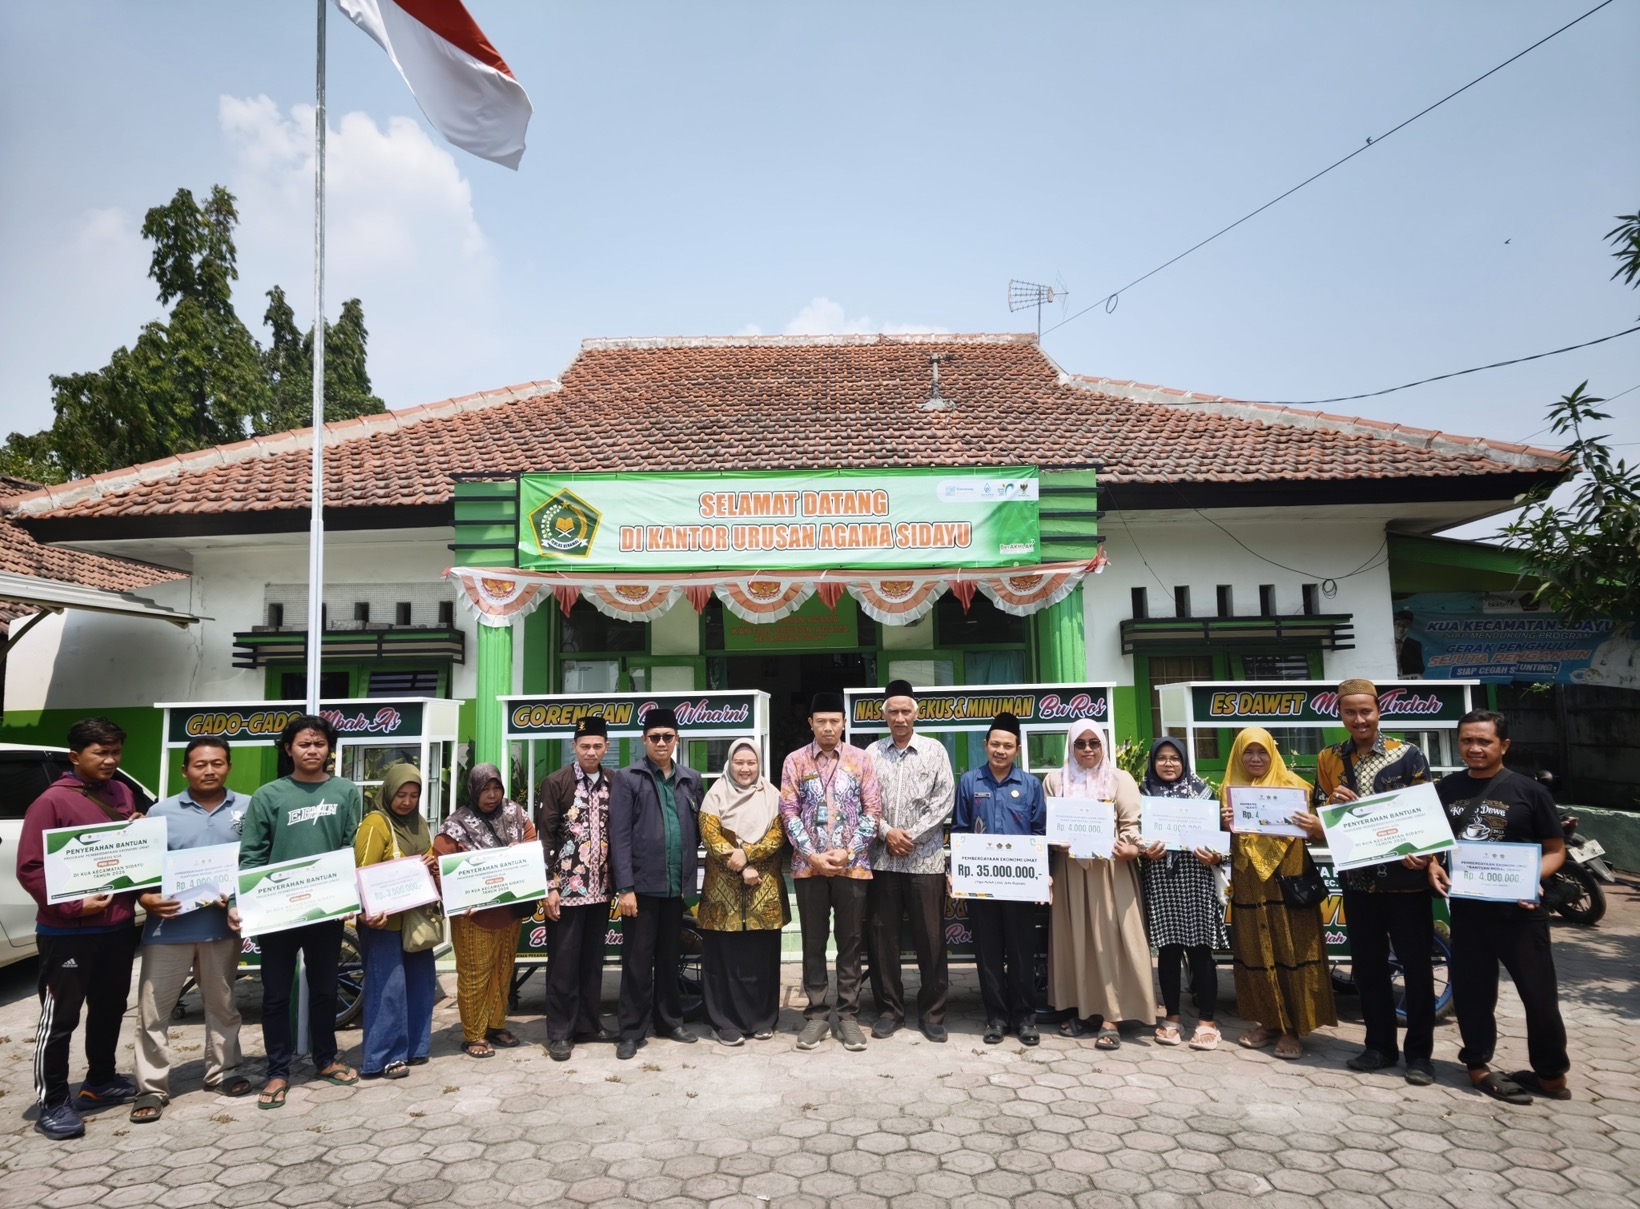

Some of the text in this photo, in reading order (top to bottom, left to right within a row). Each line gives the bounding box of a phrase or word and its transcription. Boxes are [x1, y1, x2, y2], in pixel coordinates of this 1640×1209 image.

[699, 489, 889, 518] SELAMAT DATANG
[620, 521, 972, 552] DI KANTOR URUSAN AGAMA SIDAYU
[1426, 621, 1460, 631] KUA
[1462, 620, 1557, 631] KECAMATAN
[1447, 642, 1577, 653] GERAK PENGHULU
[1456, 667, 1477, 676] SIAP
[673, 699, 748, 725] Winarni
[854, 699, 884, 721] NAS
[966, 695, 1035, 718] MINUMAN
[1039, 694, 1107, 719] Bu Ros
[1210, 693, 1237, 716] ES
[1238, 692, 1307, 715] DAWET
[1377, 688, 1443, 717] Indah
[512, 702, 634, 728] GORENGAN
[1343, 808, 1422, 828] PENYERAHAN BANTUAN
[66, 839, 148, 855] PENYERAHAN BANTUAN
[92, 866, 124, 874] KECAMATAN
[458, 859, 527, 876] PENYERAHAN BANTUAN
[958, 864, 1042, 880] Rp. 35.000.000,-
[258, 880, 304, 894] PENYERAHAN
[306, 872, 337, 883] BANTUAN
